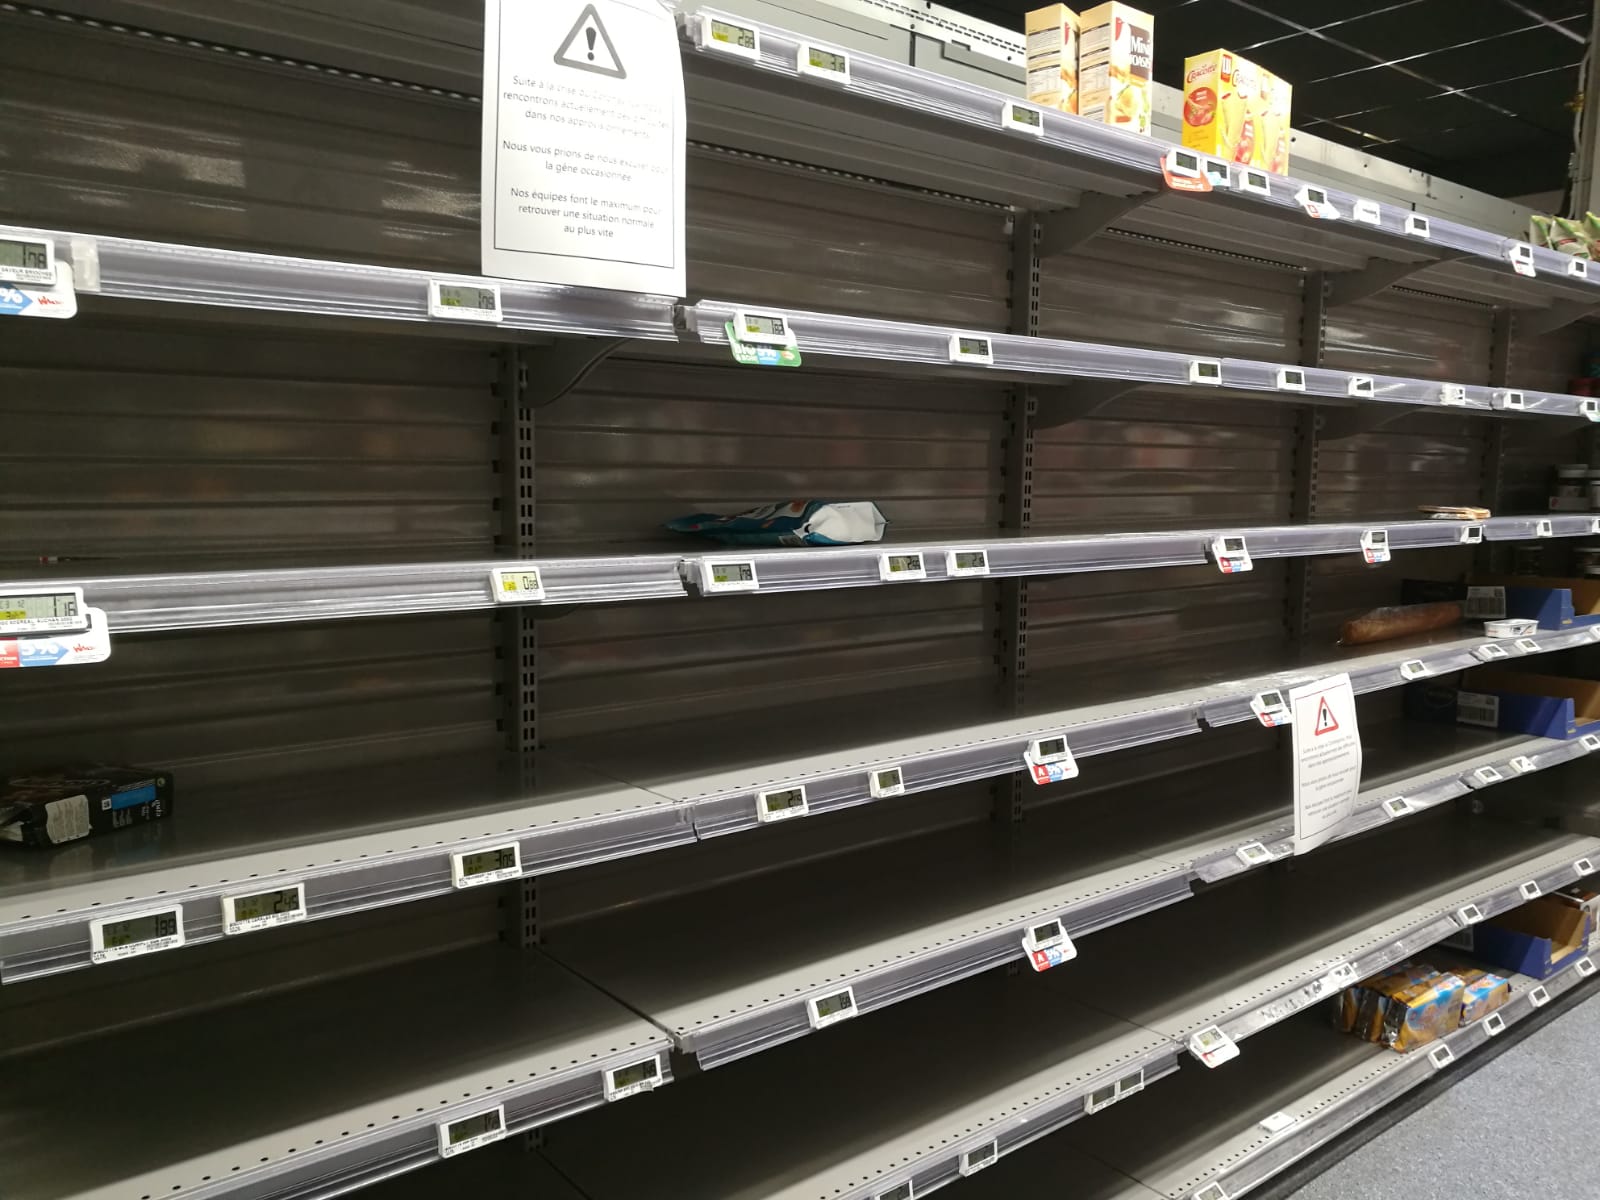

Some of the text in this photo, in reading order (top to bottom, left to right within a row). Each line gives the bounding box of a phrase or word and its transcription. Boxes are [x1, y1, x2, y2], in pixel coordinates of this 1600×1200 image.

[513, 75, 536, 87] Suite
[538, 81, 544, 89] à
[503, 91, 558, 107] rencontrons
[525, 109, 547, 121] dans
[550, 114, 565, 124] nos
[503, 140, 528, 152] Nous
[530, 145, 552, 155] vous
[554, 147, 582, 159] prions
[584, 152, 595, 161] de
[597, 155, 617, 165] nous
[545, 160, 553, 170] la
[555, 163, 578, 174] gêne
[511, 187, 529, 198] Nos
[531, 189, 568, 203] équipes
[570, 194, 588, 205] font
[590, 196, 598, 206] le
[600, 199, 641, 212] maximum
[518, 205, 654, 229] retrouver une situation normale
[563, 225, 614, 238] au plus vite
